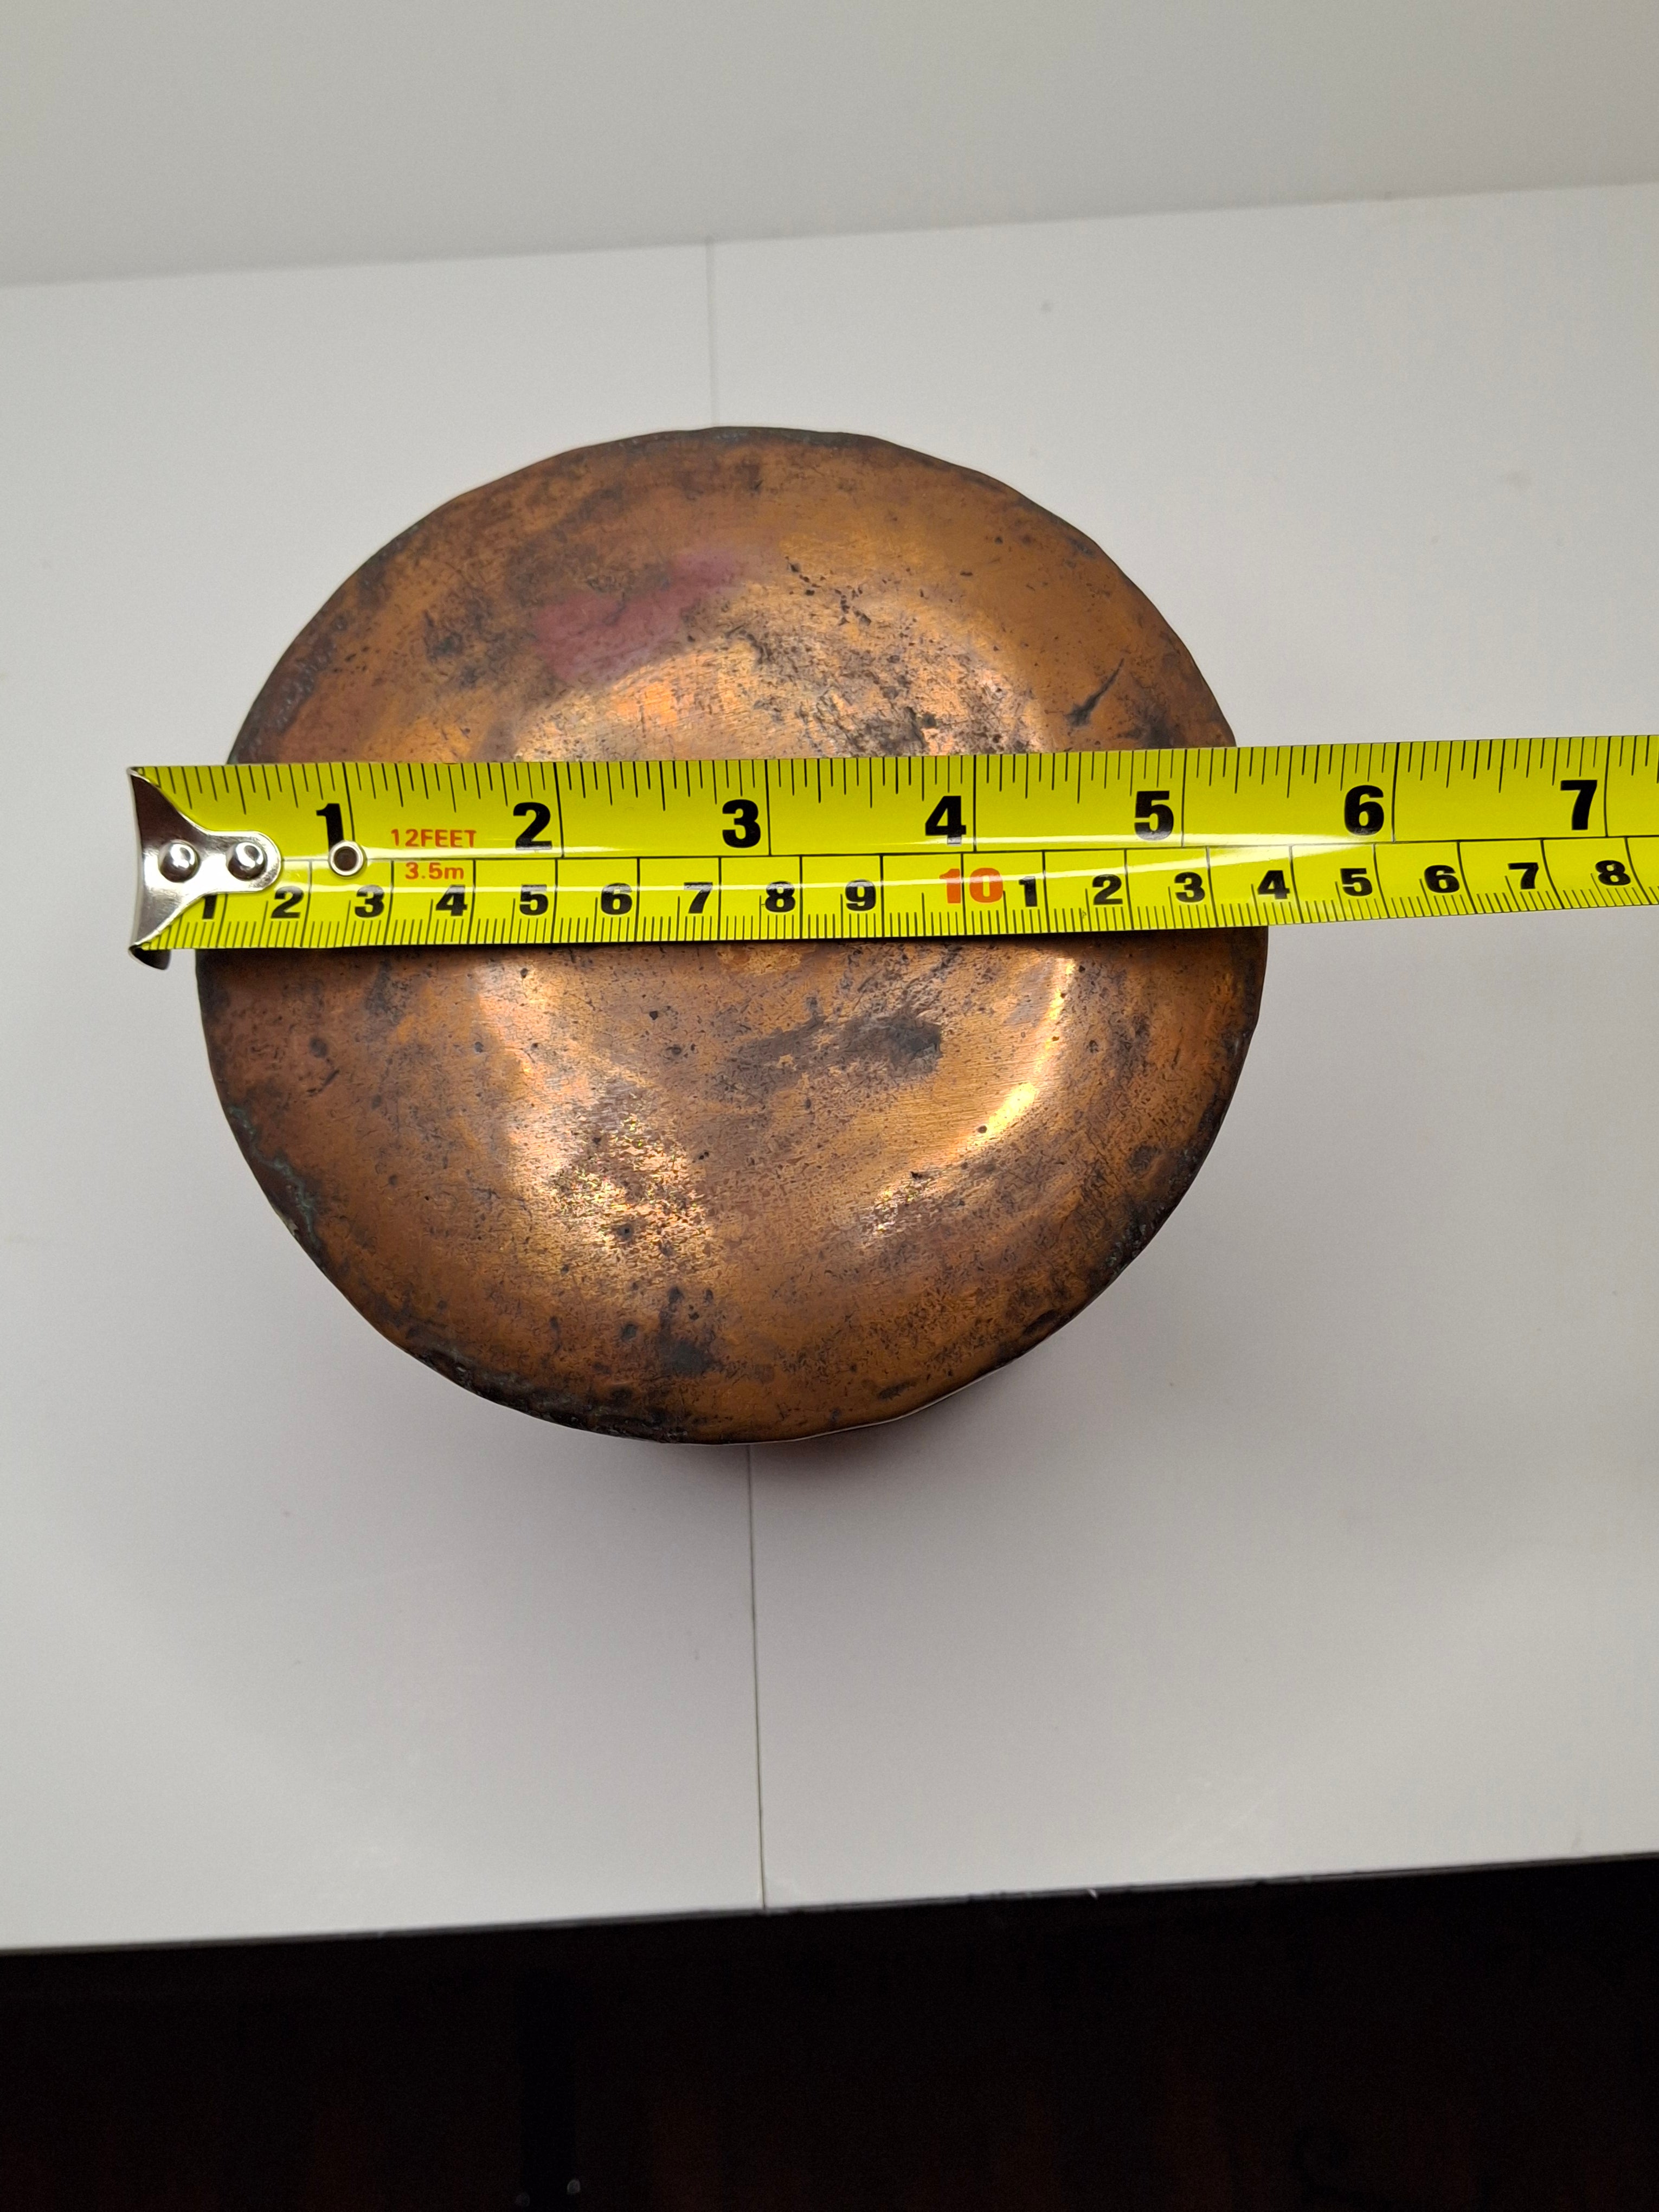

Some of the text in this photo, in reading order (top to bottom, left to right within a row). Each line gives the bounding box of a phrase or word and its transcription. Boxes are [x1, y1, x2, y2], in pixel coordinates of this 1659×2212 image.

[317, 780, 1598, 851] 1 2 3 4 5 6 7
[391, 828, 477, 848] 12FEET
[201, 860, 1631, 919] 1 2 3 4 5 6 7 8 9 10 1 2 3 4 5 6 7 8
[405, 862, 465, 880] 3.5m
